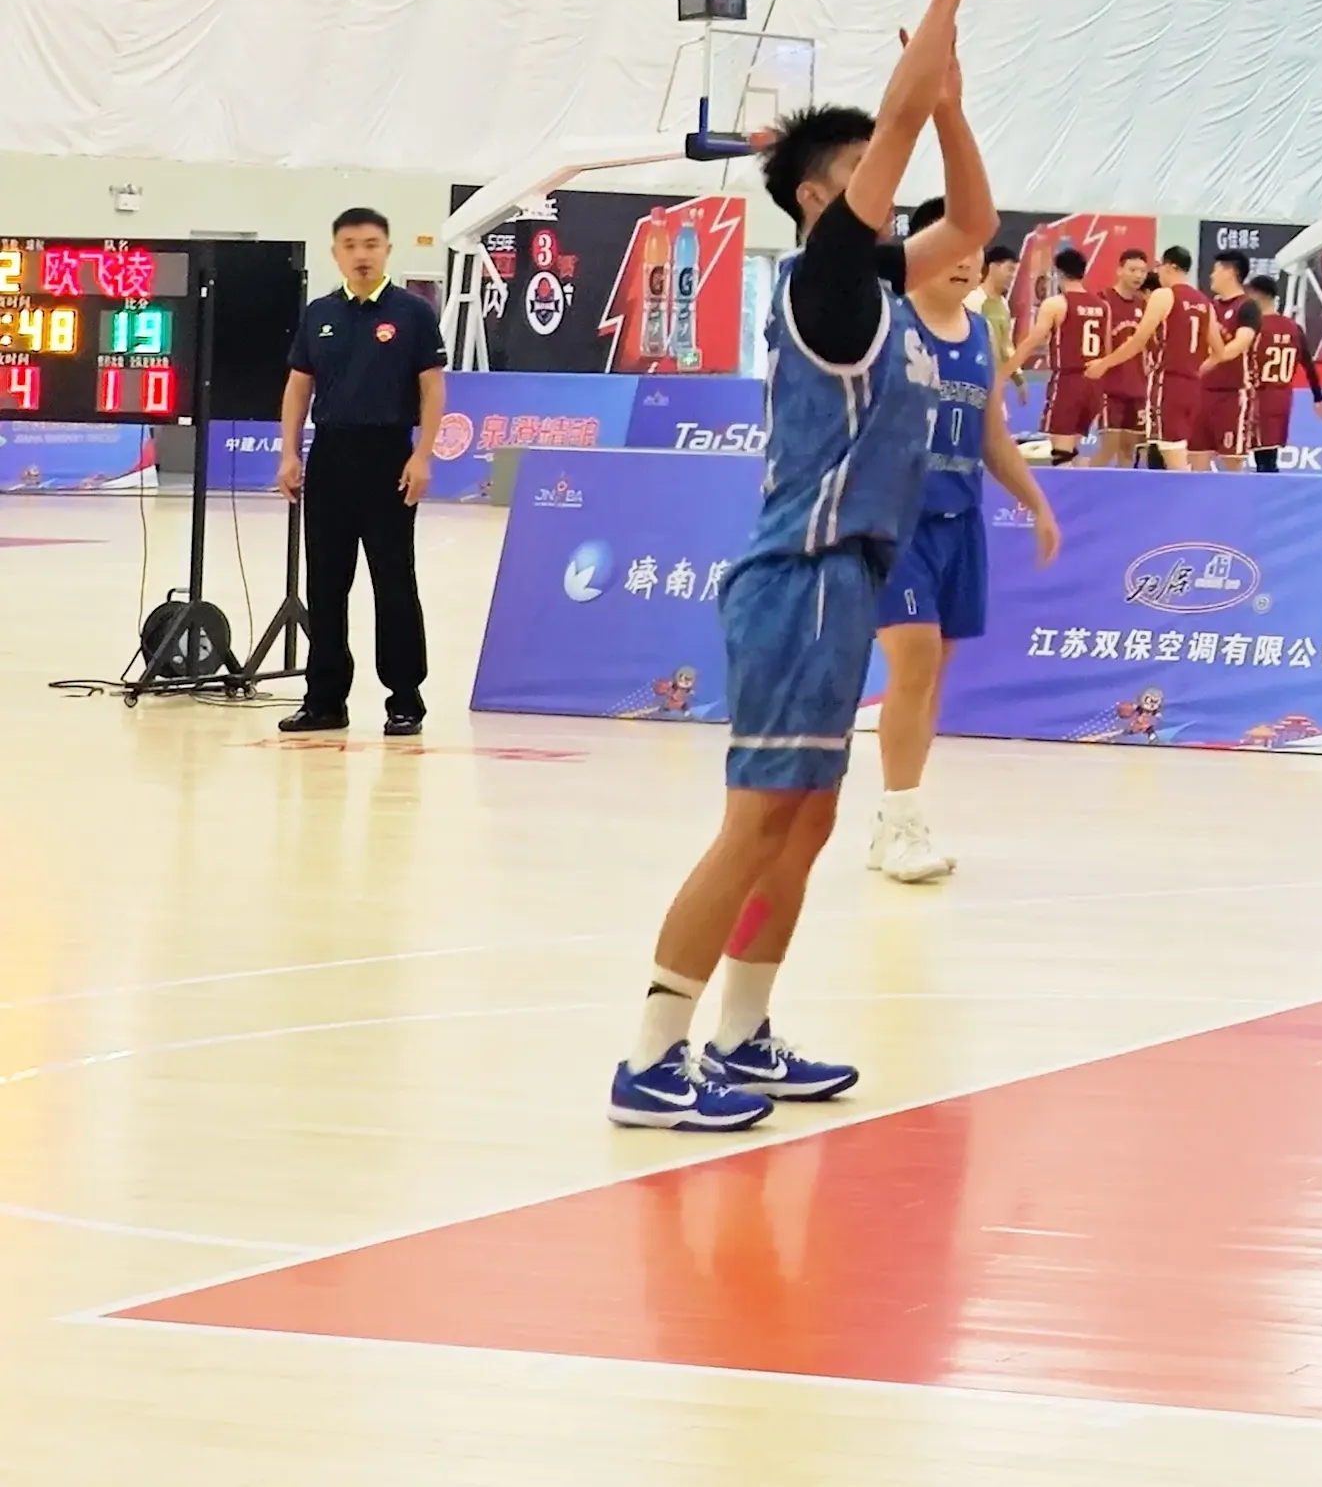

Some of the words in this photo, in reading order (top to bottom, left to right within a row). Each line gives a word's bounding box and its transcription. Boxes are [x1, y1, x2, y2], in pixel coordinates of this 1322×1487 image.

[538, 233, 553, 266] 3
[43, 250, 153, 296] 欧飞凌
[113, 310, 163, 353] 19
[1082, 319, 1101, 358] 6
[1189, 315, 1200, 354] 1
[1261, 346, 1298, 384] 20
[104, 370, 116, 411] 1
[144, 370, 170, 412] 0
